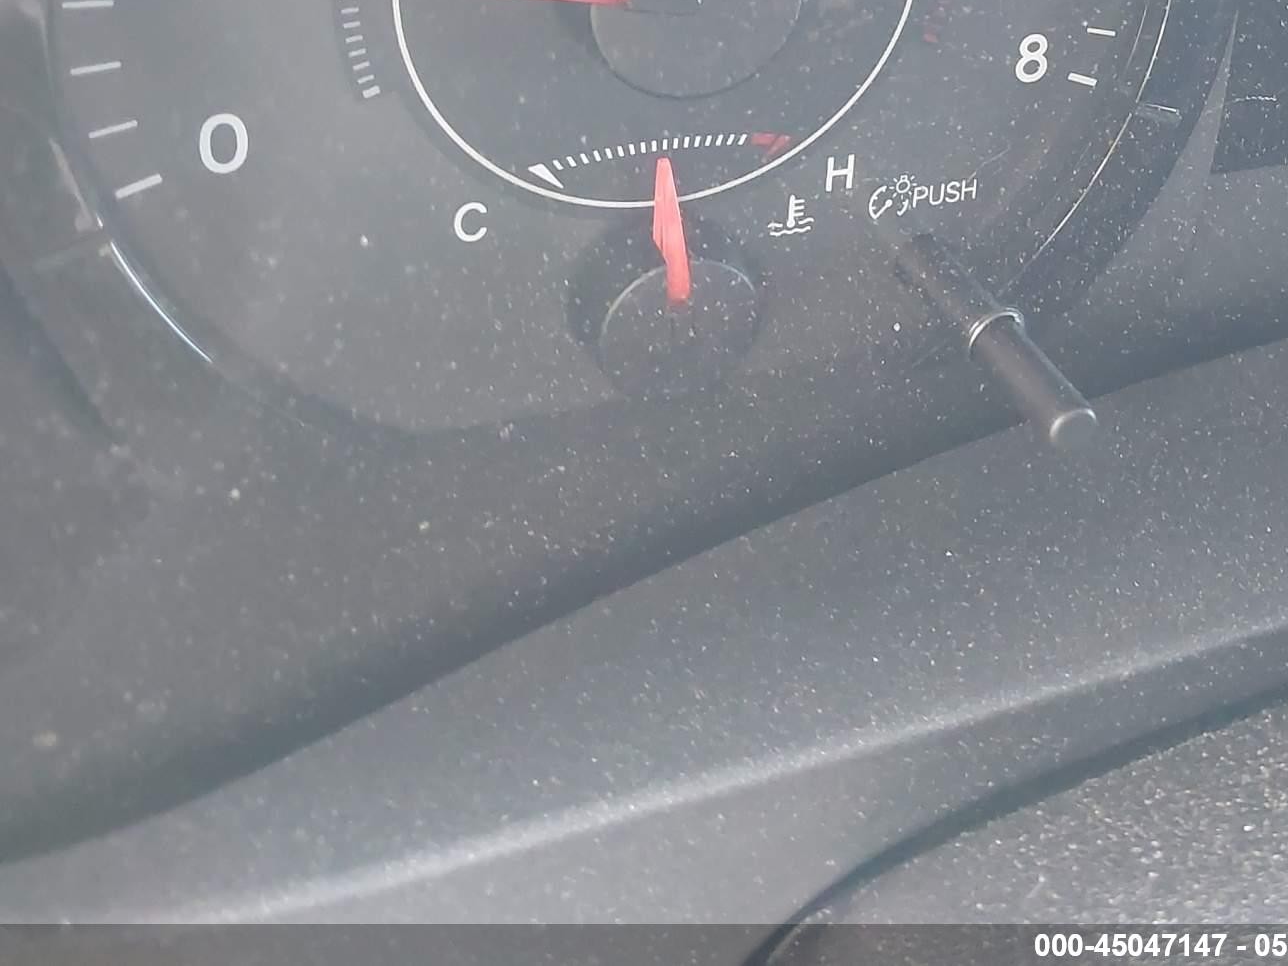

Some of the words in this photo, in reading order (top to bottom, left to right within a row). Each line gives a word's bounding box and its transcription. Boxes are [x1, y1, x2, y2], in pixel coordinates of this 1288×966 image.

[1014, 33, 1049, 84] 8
[199, 112, 249, 174] 0
[825, 153, 856, 193] H
[912, 178, 978, 209] PUSH
[452, 201, 488, 243] C
